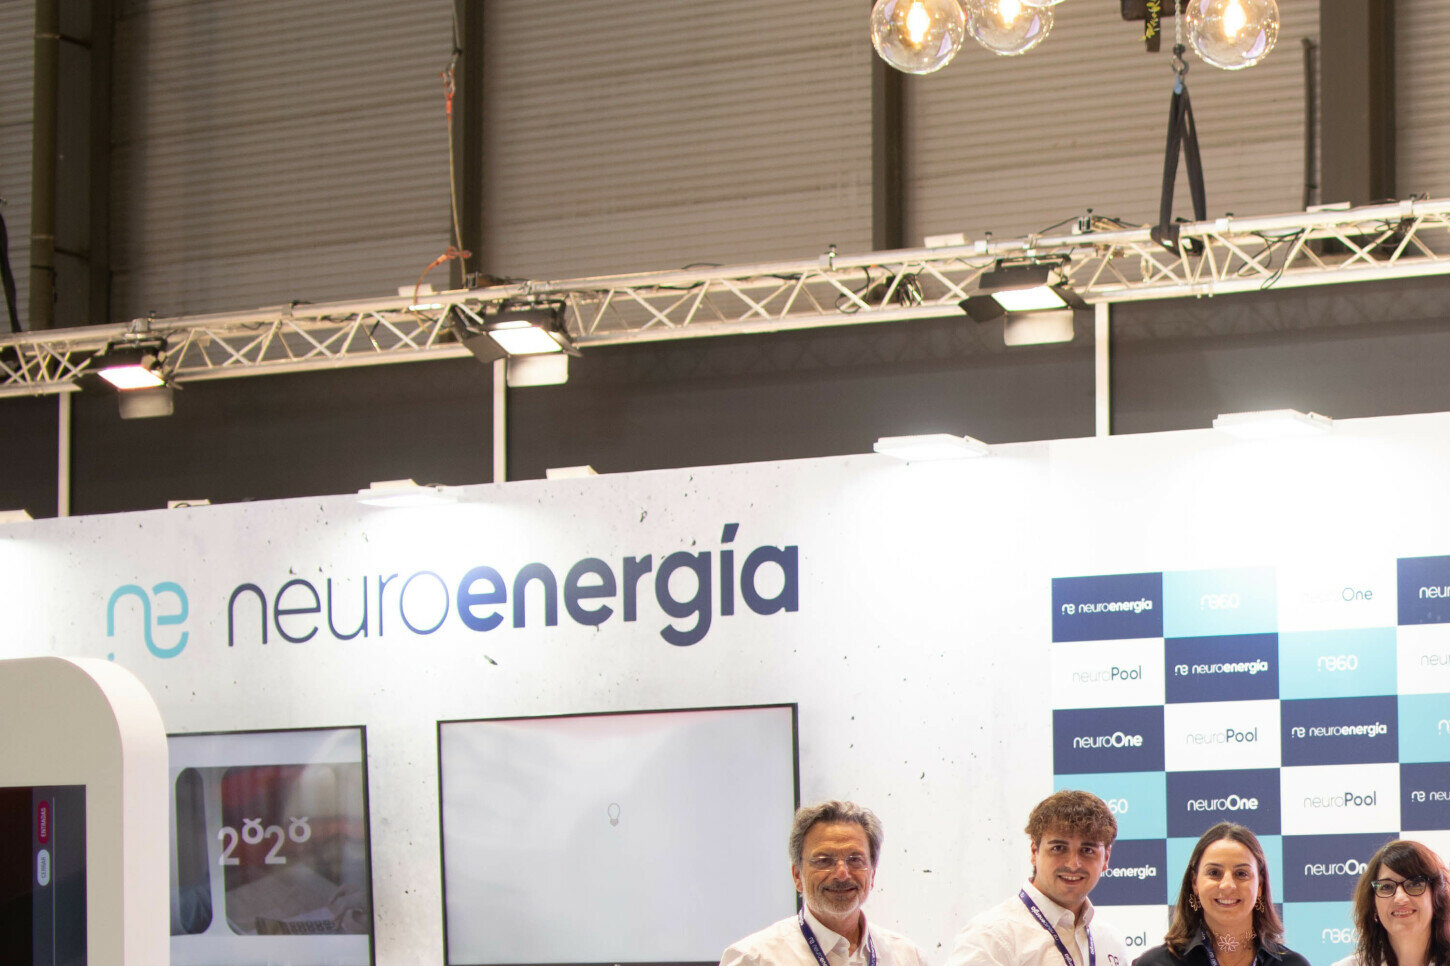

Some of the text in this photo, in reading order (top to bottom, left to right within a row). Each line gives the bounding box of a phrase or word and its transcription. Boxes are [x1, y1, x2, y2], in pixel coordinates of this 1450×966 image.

[228, 523, 799, 647] neuroenergía
[1073, 732, 1143, 749] neuroOne
[1187, 794, 1259, 812] neuroOne
[1100, 864, 1157, 880] roenergía
[1304, 859, 1367, 875] neuroOn
